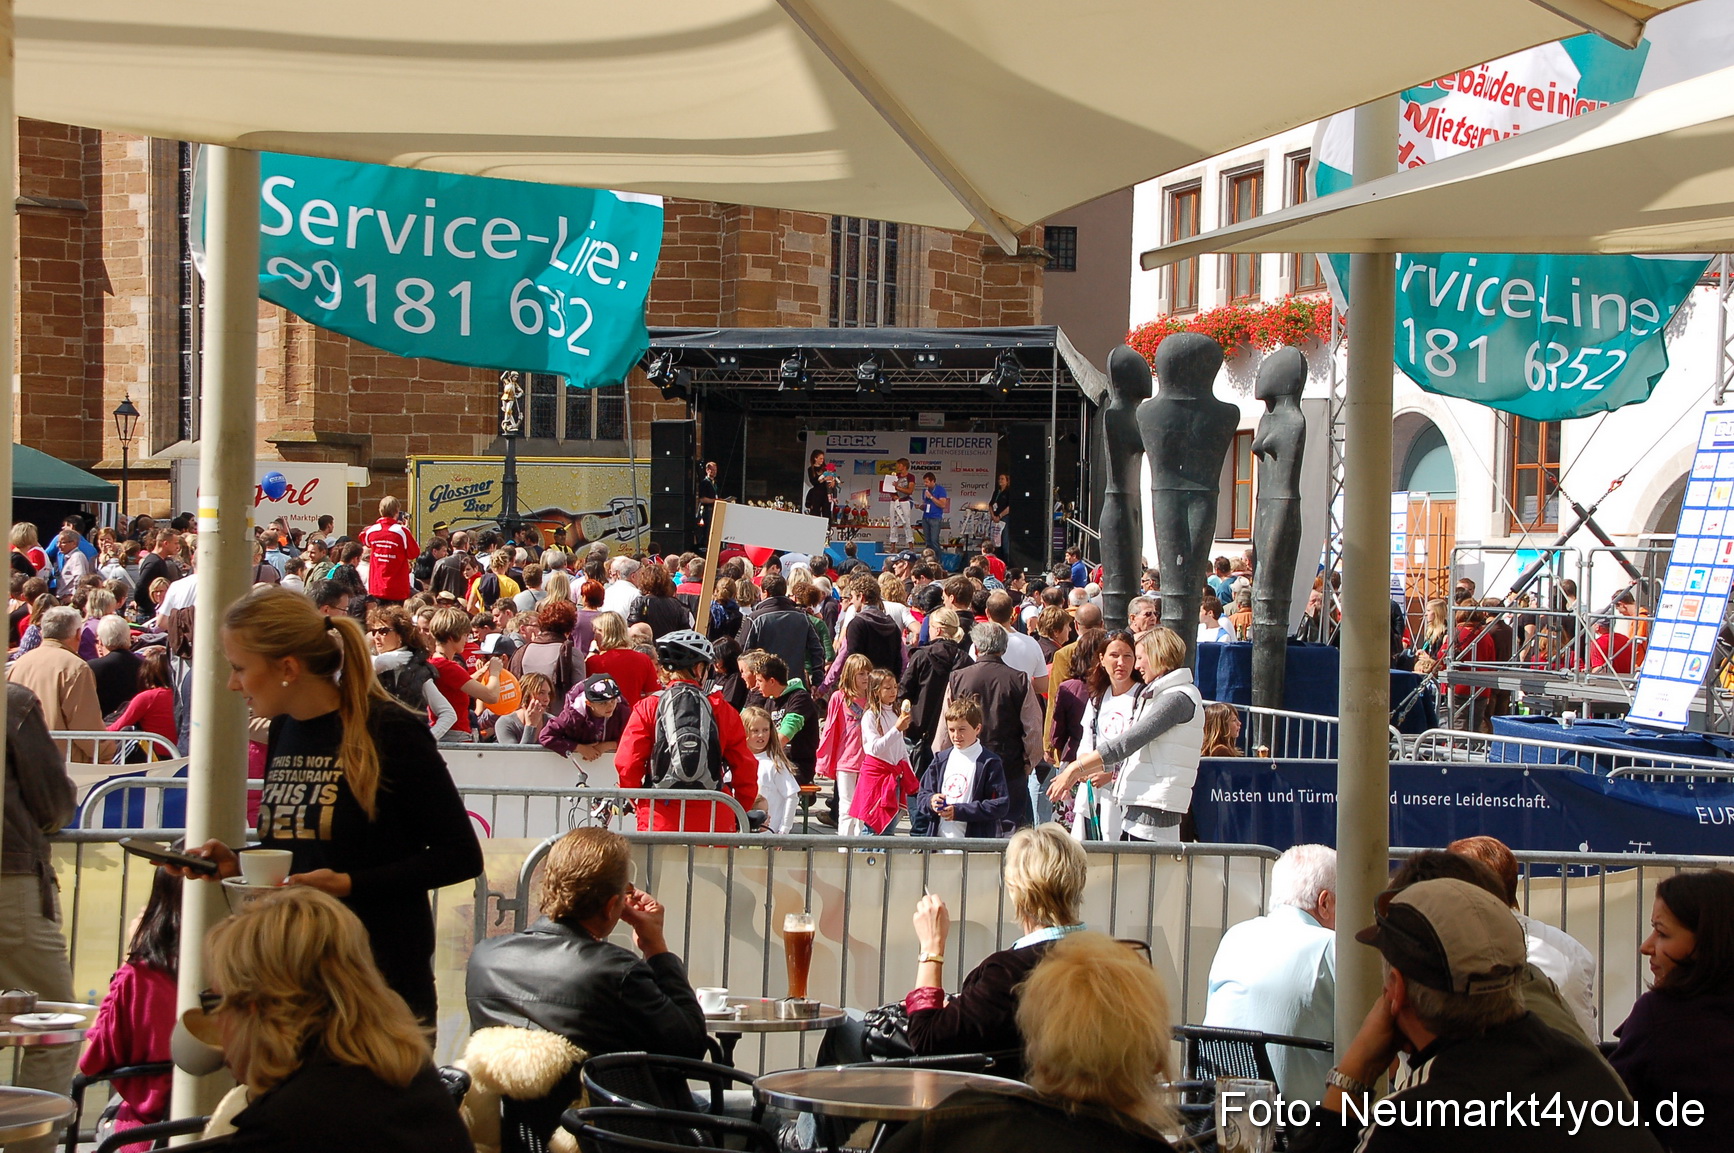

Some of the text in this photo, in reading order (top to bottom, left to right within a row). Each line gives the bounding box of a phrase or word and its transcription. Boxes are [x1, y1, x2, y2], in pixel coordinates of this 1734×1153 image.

[1524, 340, 1627, 393] 6352
[928, 436, 993, 449] PFLEIDERER
[428, 479, 495, 514] Glossner
[462, 497, 494, 513] Bier
[272, 755, 344, 768] THIS IS NOT A
[268, 770, 343, 782] RESTAURANT
[261, 784, 339, 804] THIS IS
[1210, 788, 1262, 803] Masten
[1267, 788, 1294, 803] und
[1403, 793, 1451, 806] unsere
[1456, 792, 1551, 809] Leidenschaft.
[257, 805, 335, 840] DELI
